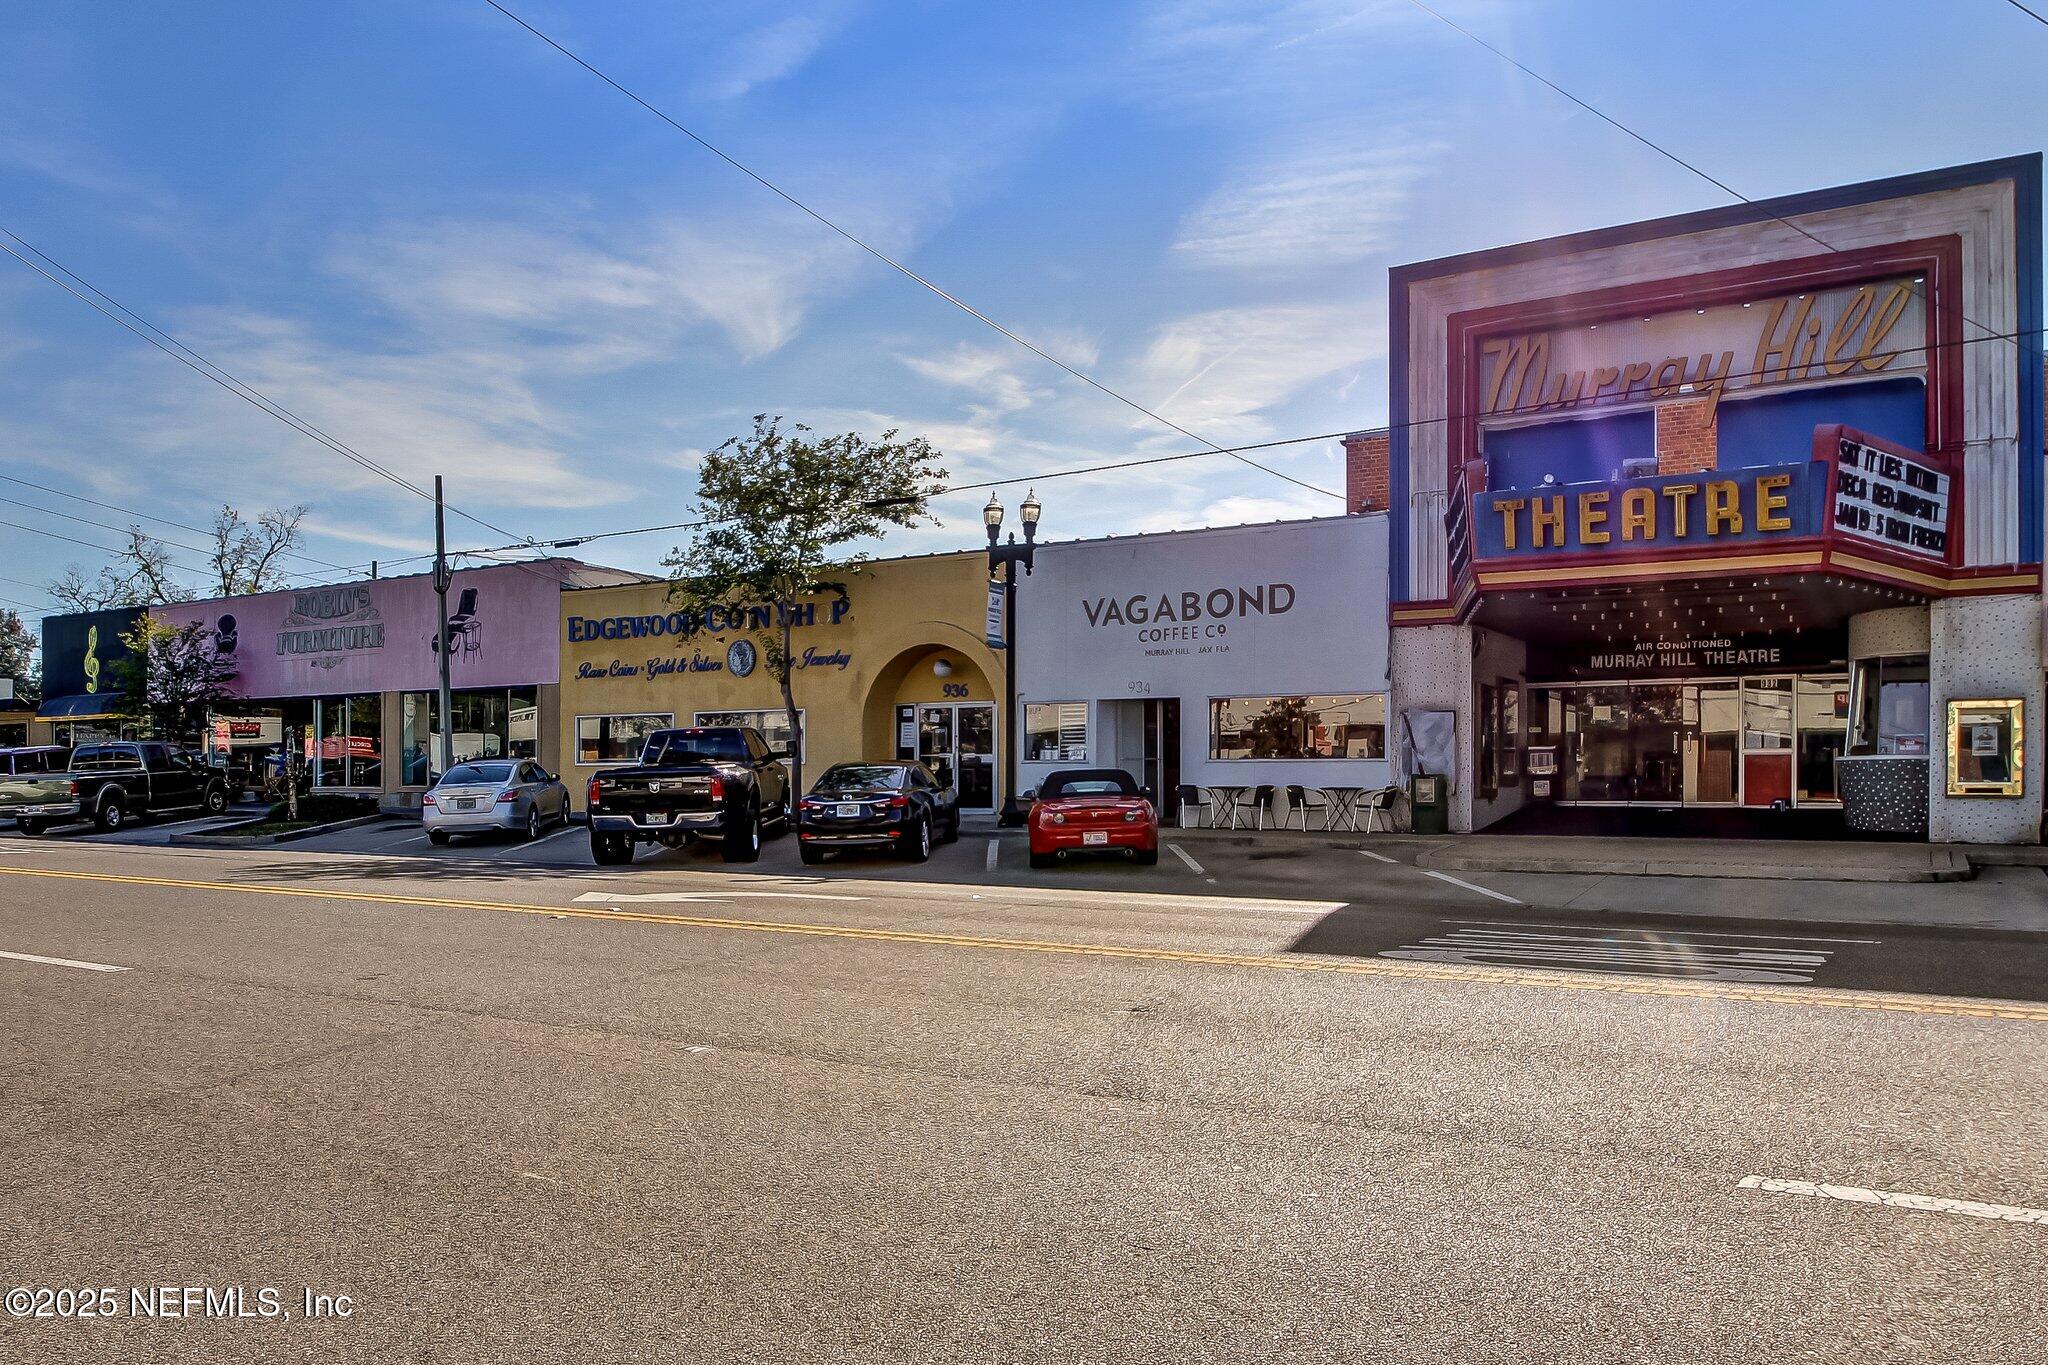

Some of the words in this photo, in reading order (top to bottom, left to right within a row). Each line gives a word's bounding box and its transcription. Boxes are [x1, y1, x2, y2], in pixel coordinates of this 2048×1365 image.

[1482, 334, 1733, 428] Murray
[1750, 284, 1913, 386] Hill
[1493, 474, 1791, 550] THEATRE
[293, 586, 370, 618] ROBIN'S
[1082, 583, 1297, 628] VAGABOND
[276, 623, 385, 655] FURNITURE
[1138, 626, 1199, 643] COFFEE
[1635, 643, 1653, 651] AIR
[1656, 639, 1731, 649] CONDITIONED
[796, 646, 852, 671] Jewelry
[1198, 646, 1213, 654] JAX
[1216, 645, 1231, 653] FLA
[1591, 654, 1655, 669] MURRAY
[1660, 652, 1696, 667] HILL
[1704, 648, 1780, 665] THEATRE
[609, 659, 639, 678] Coins
[647, 657, 677, 681] Gold
[689, 653, 724, 673] Silver
[943, 683, 969, 698] 936
[1128, 681, 1151, 695] 934
[1760, 679, 1778, 688] 932
